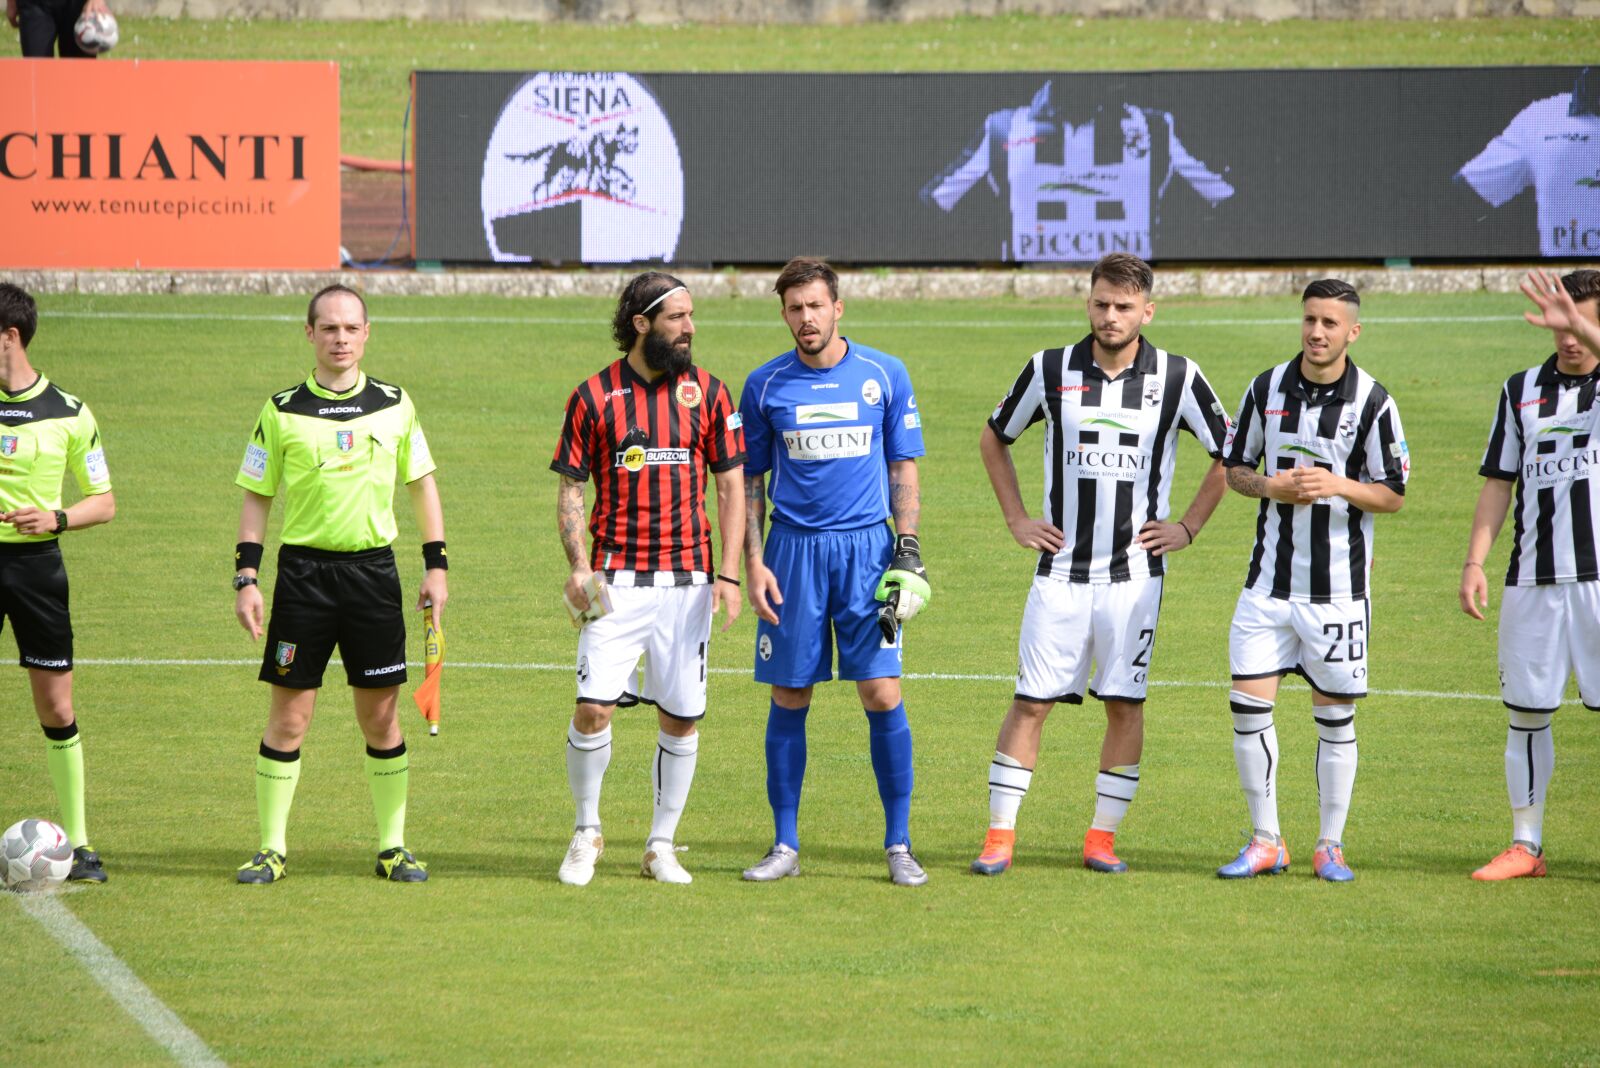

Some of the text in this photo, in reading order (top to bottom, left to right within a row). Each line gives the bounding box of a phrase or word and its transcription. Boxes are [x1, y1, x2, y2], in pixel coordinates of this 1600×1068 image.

[534, 86, 631, 114] SIENA
[0, 131, 309, 181] CHIANTI
[31, 197, 276, 219] www.tenutepiccini.it
[1019, 224, 1144, 256] PICCINI
[318, 406, 363, 415] DIADORA
[785, 431, 868, 450] PICCINI
[625, 454, 644, 464] BFT
[1066, 444, 1146, 470] PICCINI
[1526, 450, 1599, 479] PICCINI
[1132, 628, 1154, 667] 2
[1323, 620, 1364, 662] 26
[25, 656, 69, 667] DIADORA
[364, 662, 406, 676] DIADORA
